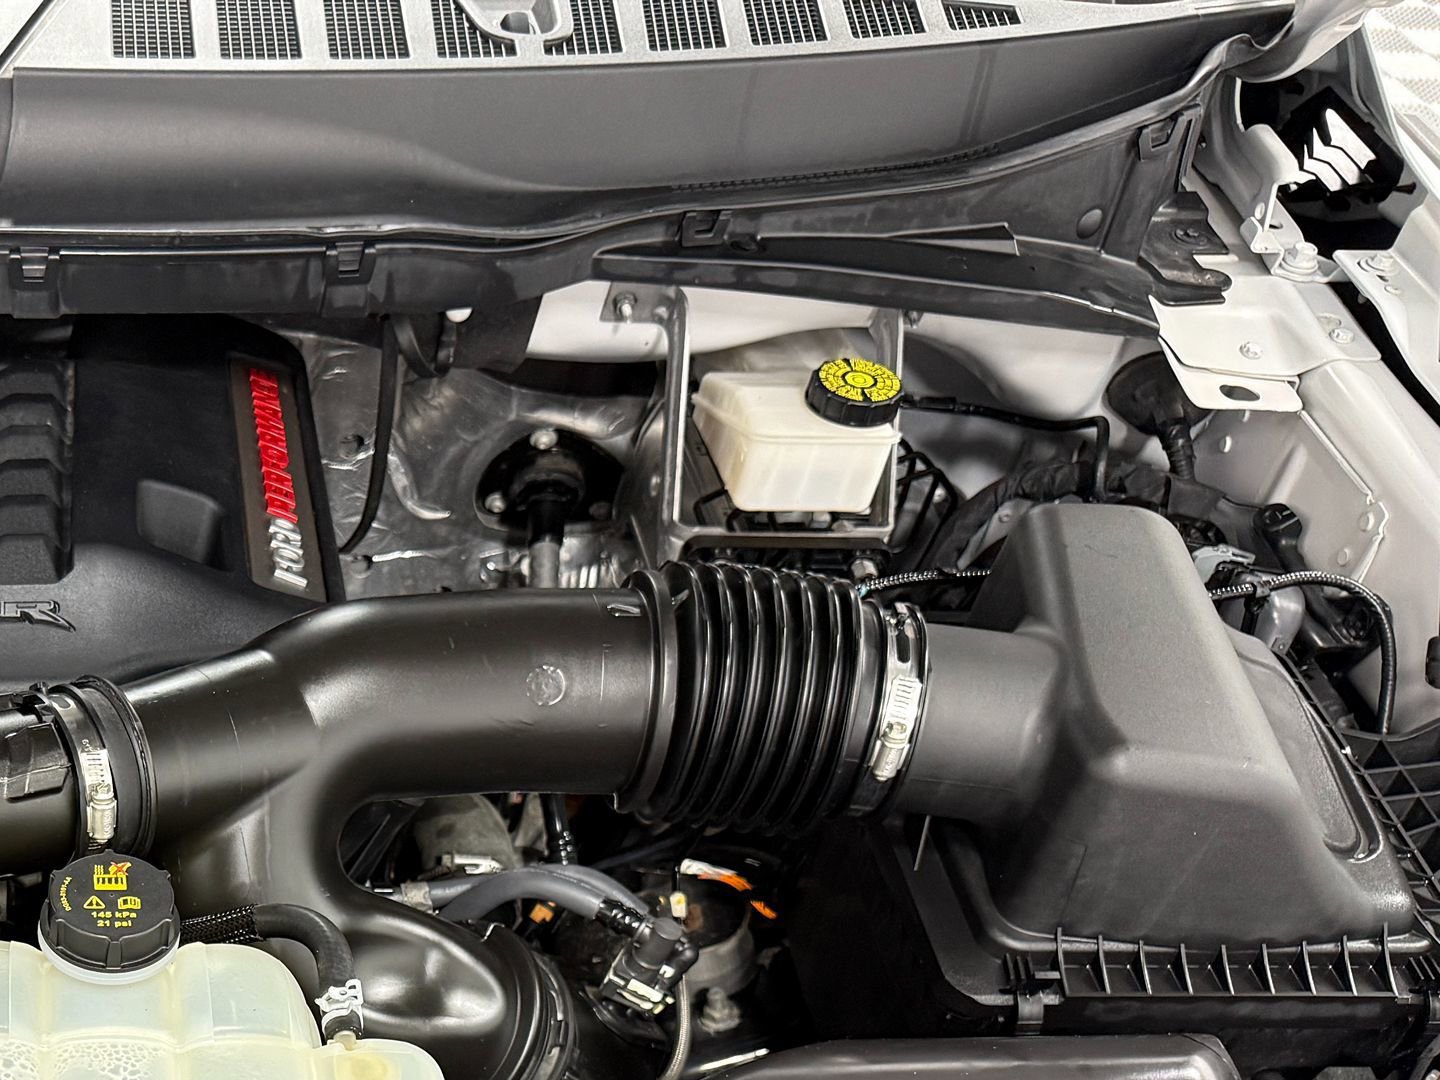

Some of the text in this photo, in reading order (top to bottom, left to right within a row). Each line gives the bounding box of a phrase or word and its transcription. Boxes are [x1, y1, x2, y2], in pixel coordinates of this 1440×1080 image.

[250, 367, 309, 588] FORD PERFORMANCE
[90, 911, 137, 919] 145 kPa
